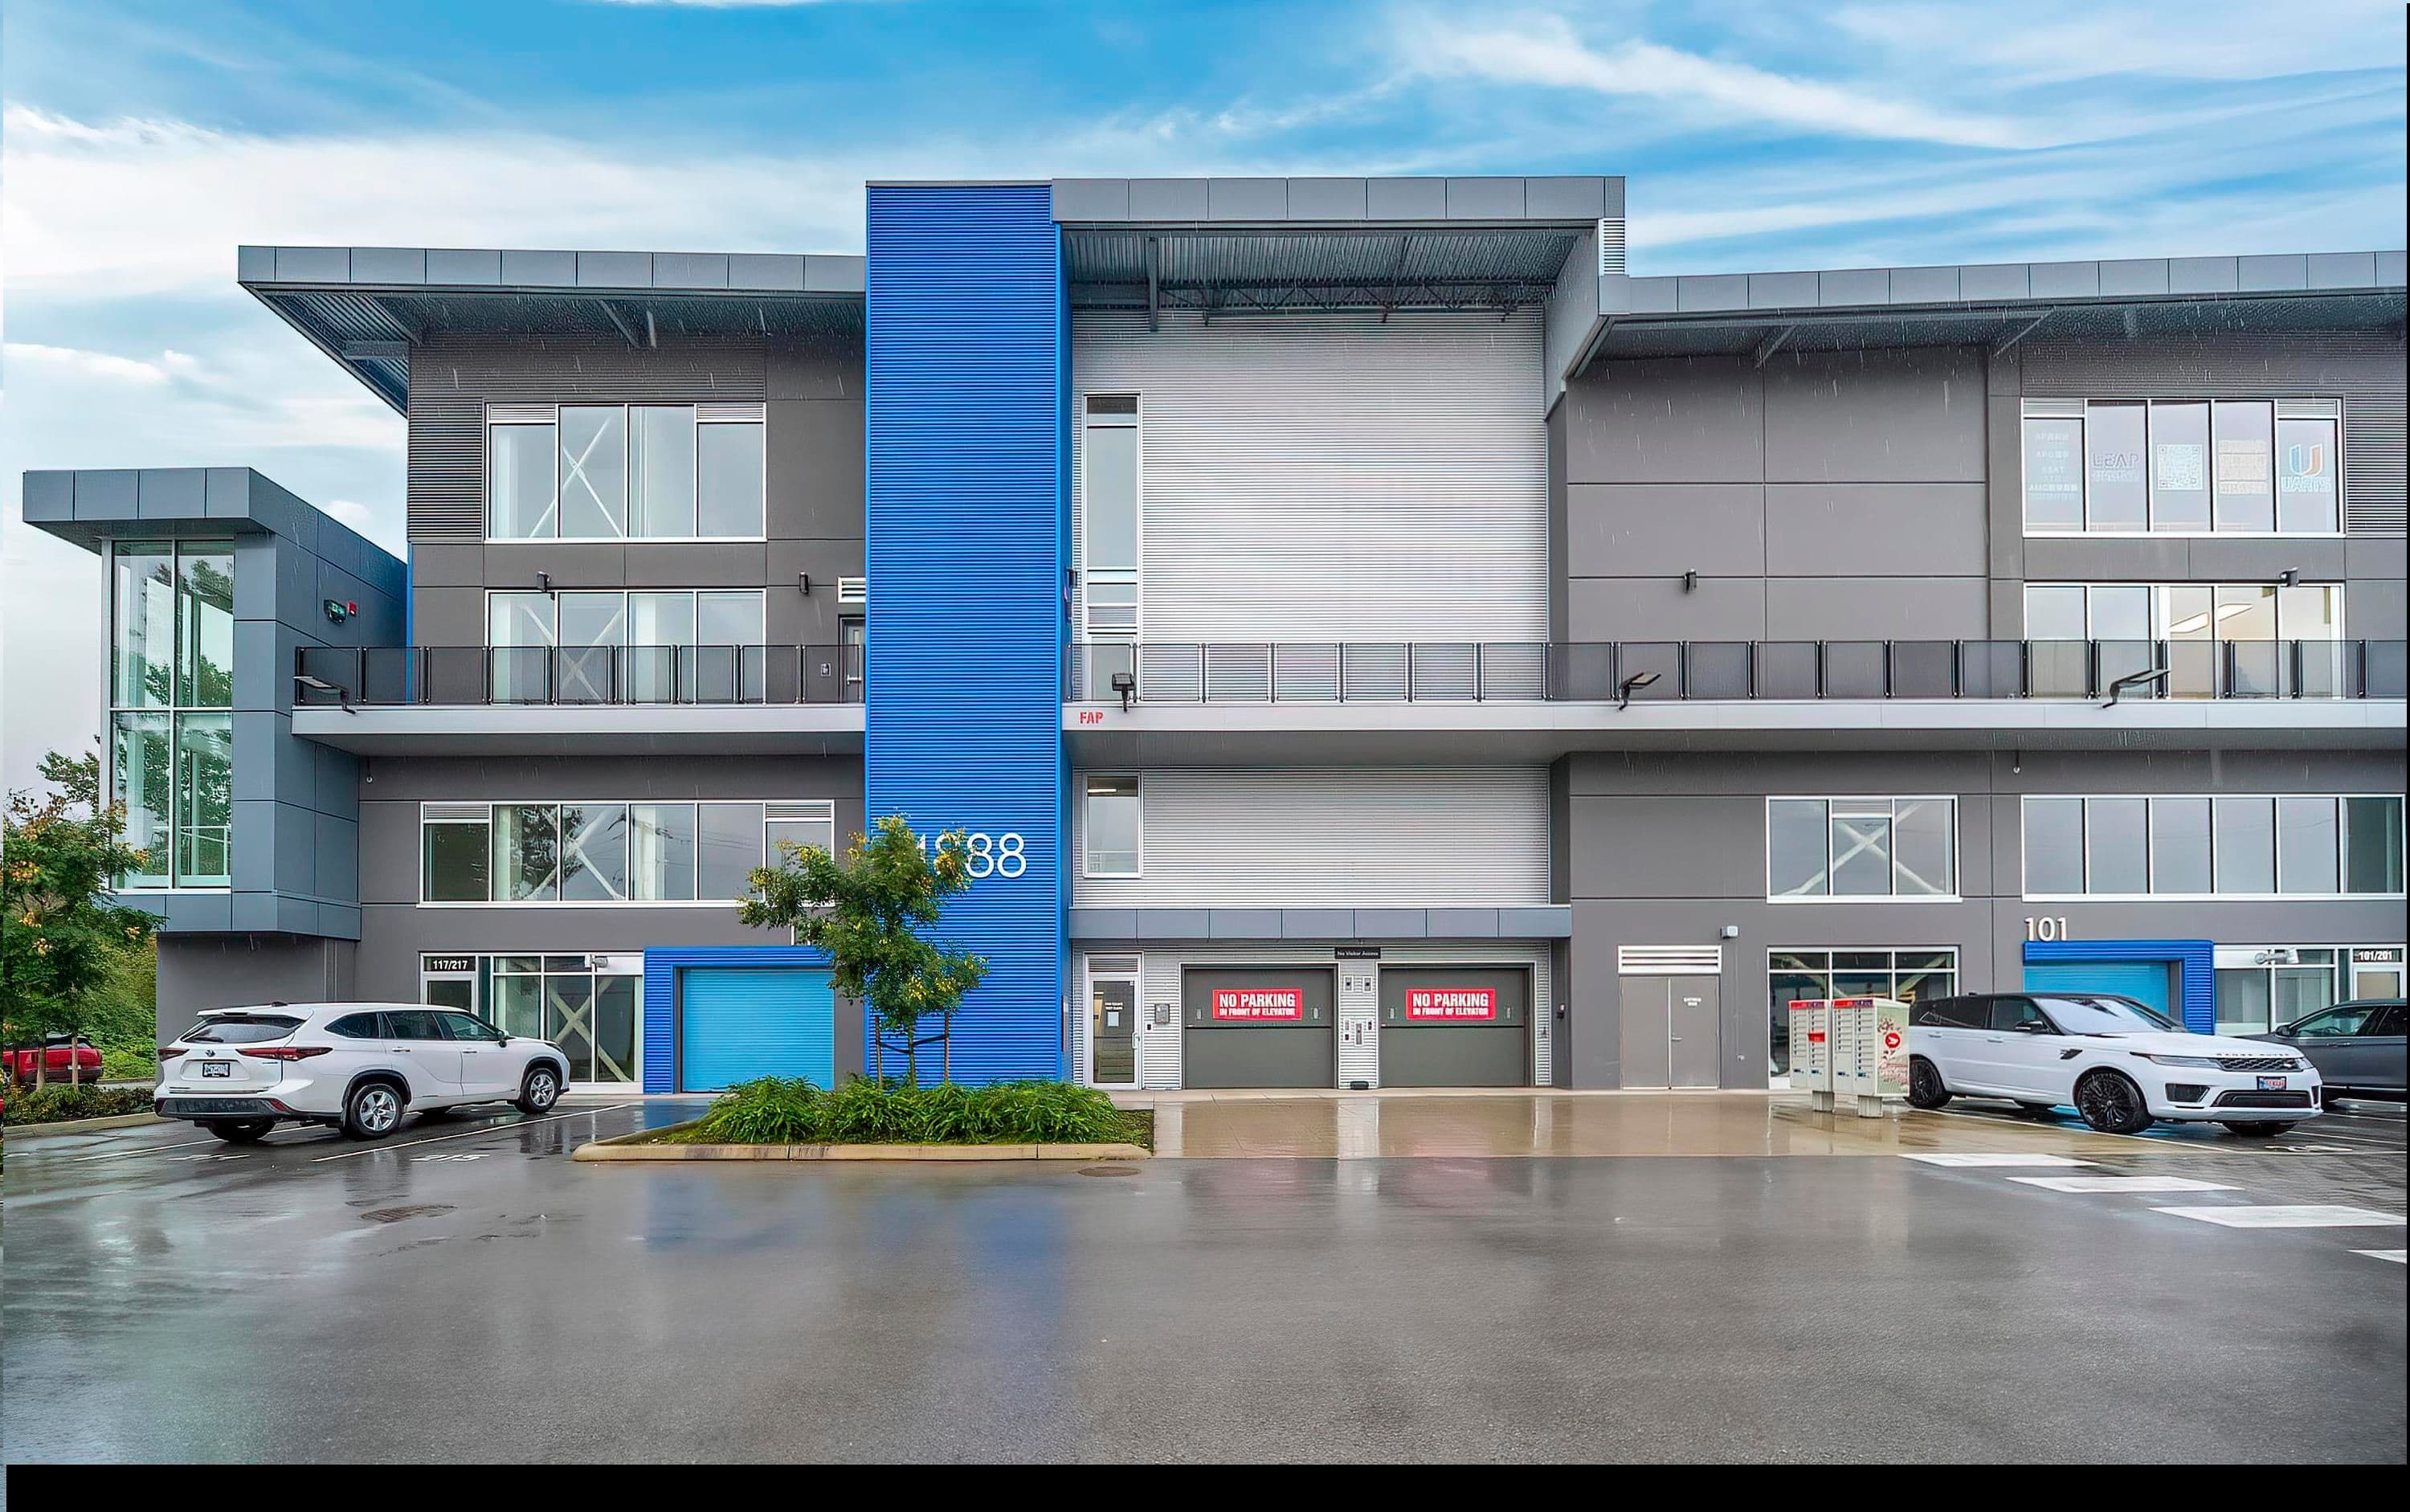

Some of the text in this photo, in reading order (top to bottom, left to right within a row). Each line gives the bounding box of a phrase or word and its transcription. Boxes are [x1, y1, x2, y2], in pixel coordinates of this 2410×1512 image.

[1080, 712, 1104, 724] FAP
[2024, 917, 2068, 942] 101
[2359, 950, 2392, 961] 101/201
[432, 960, 468, 971] 117/217
[1219, 993, 1296, 1007] NO PARKING
[1412, 993, 1489, 1007] NO PARKING
[1228, 1007, 1251, 1015] FRONT
[1252, 1007, 1260, 1015] OF
[1262, 1007, 1295, 1015] ELEVATOR
[1422, 1007, 1444, 1015] FRONT
[1444, 1007, 1454, 1015] OF
[1456, 1007, 1489, 1015] ELEVATOR
